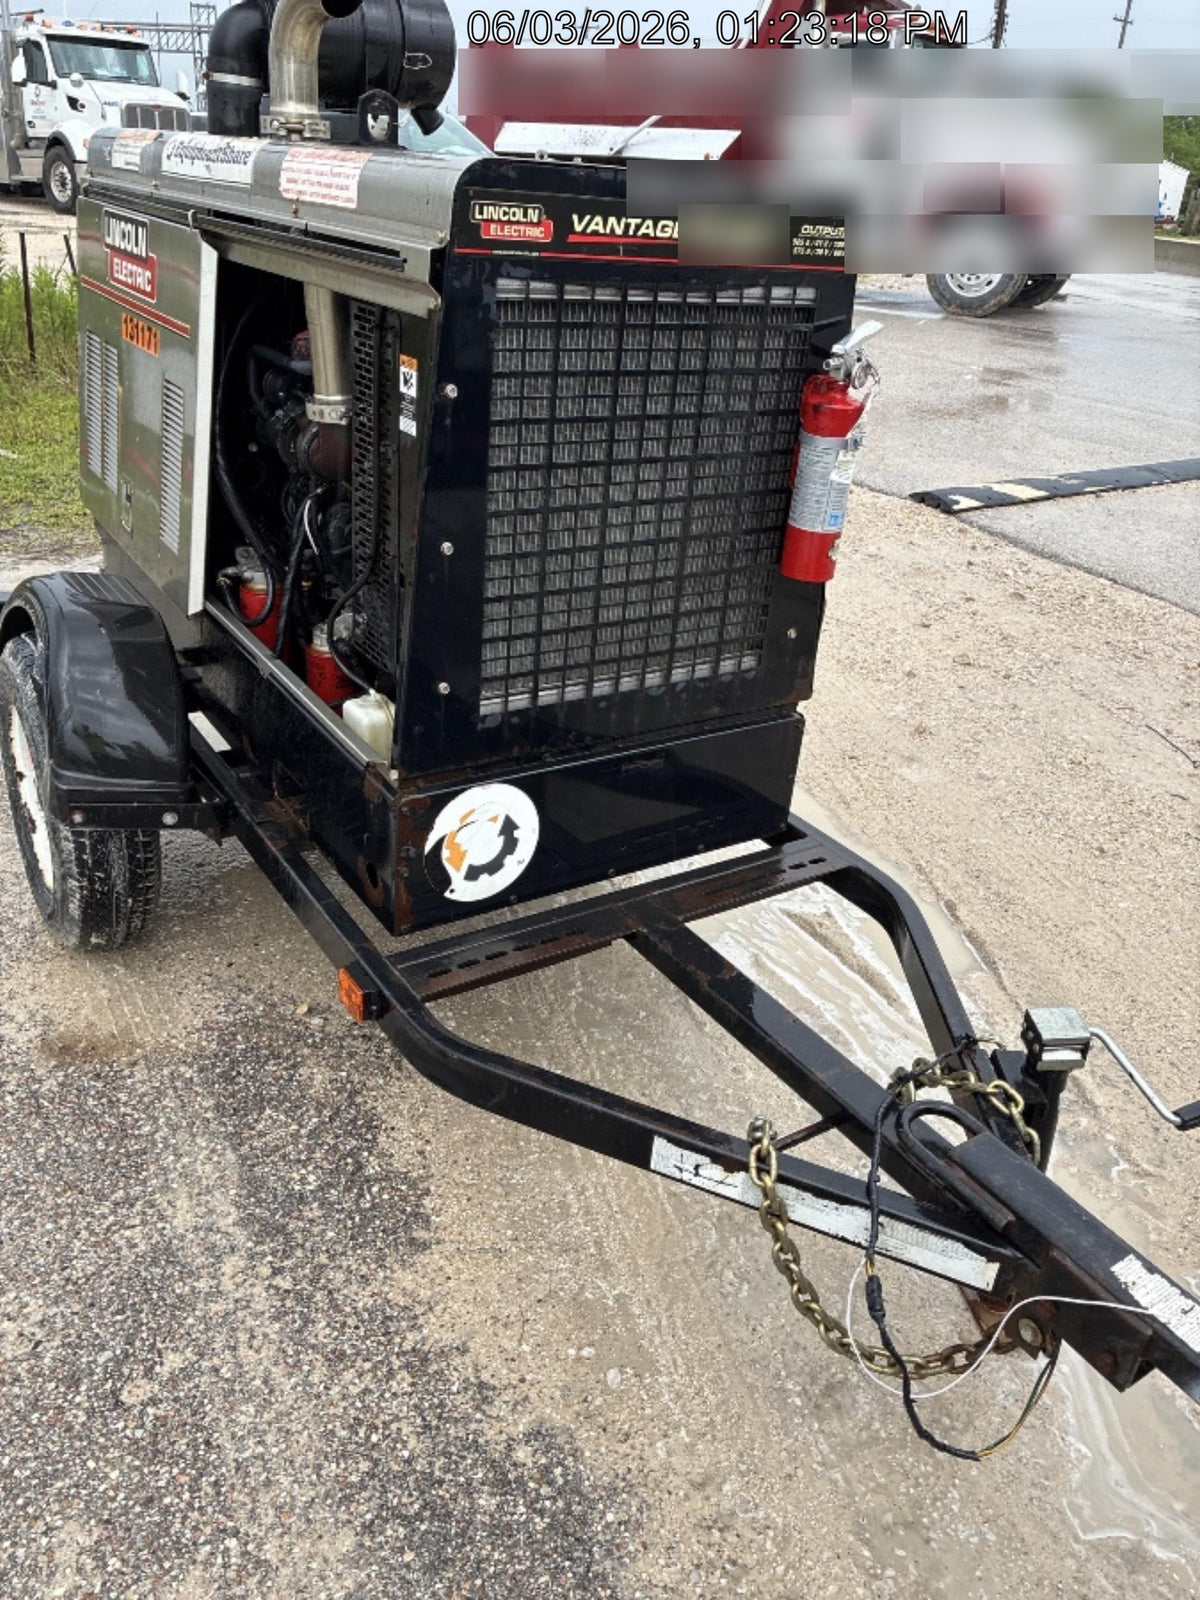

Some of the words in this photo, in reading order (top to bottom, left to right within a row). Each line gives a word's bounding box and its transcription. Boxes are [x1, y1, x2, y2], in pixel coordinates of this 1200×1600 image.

[474, 204, 540, 223] LINCOLN
[489, 224, 545, 238] ELECTRIC
[103, 215, 147, 259] LINCOLN
[112, 256, 153, 293] ELECTRIC
[122, 314, 159, 355] 131171
